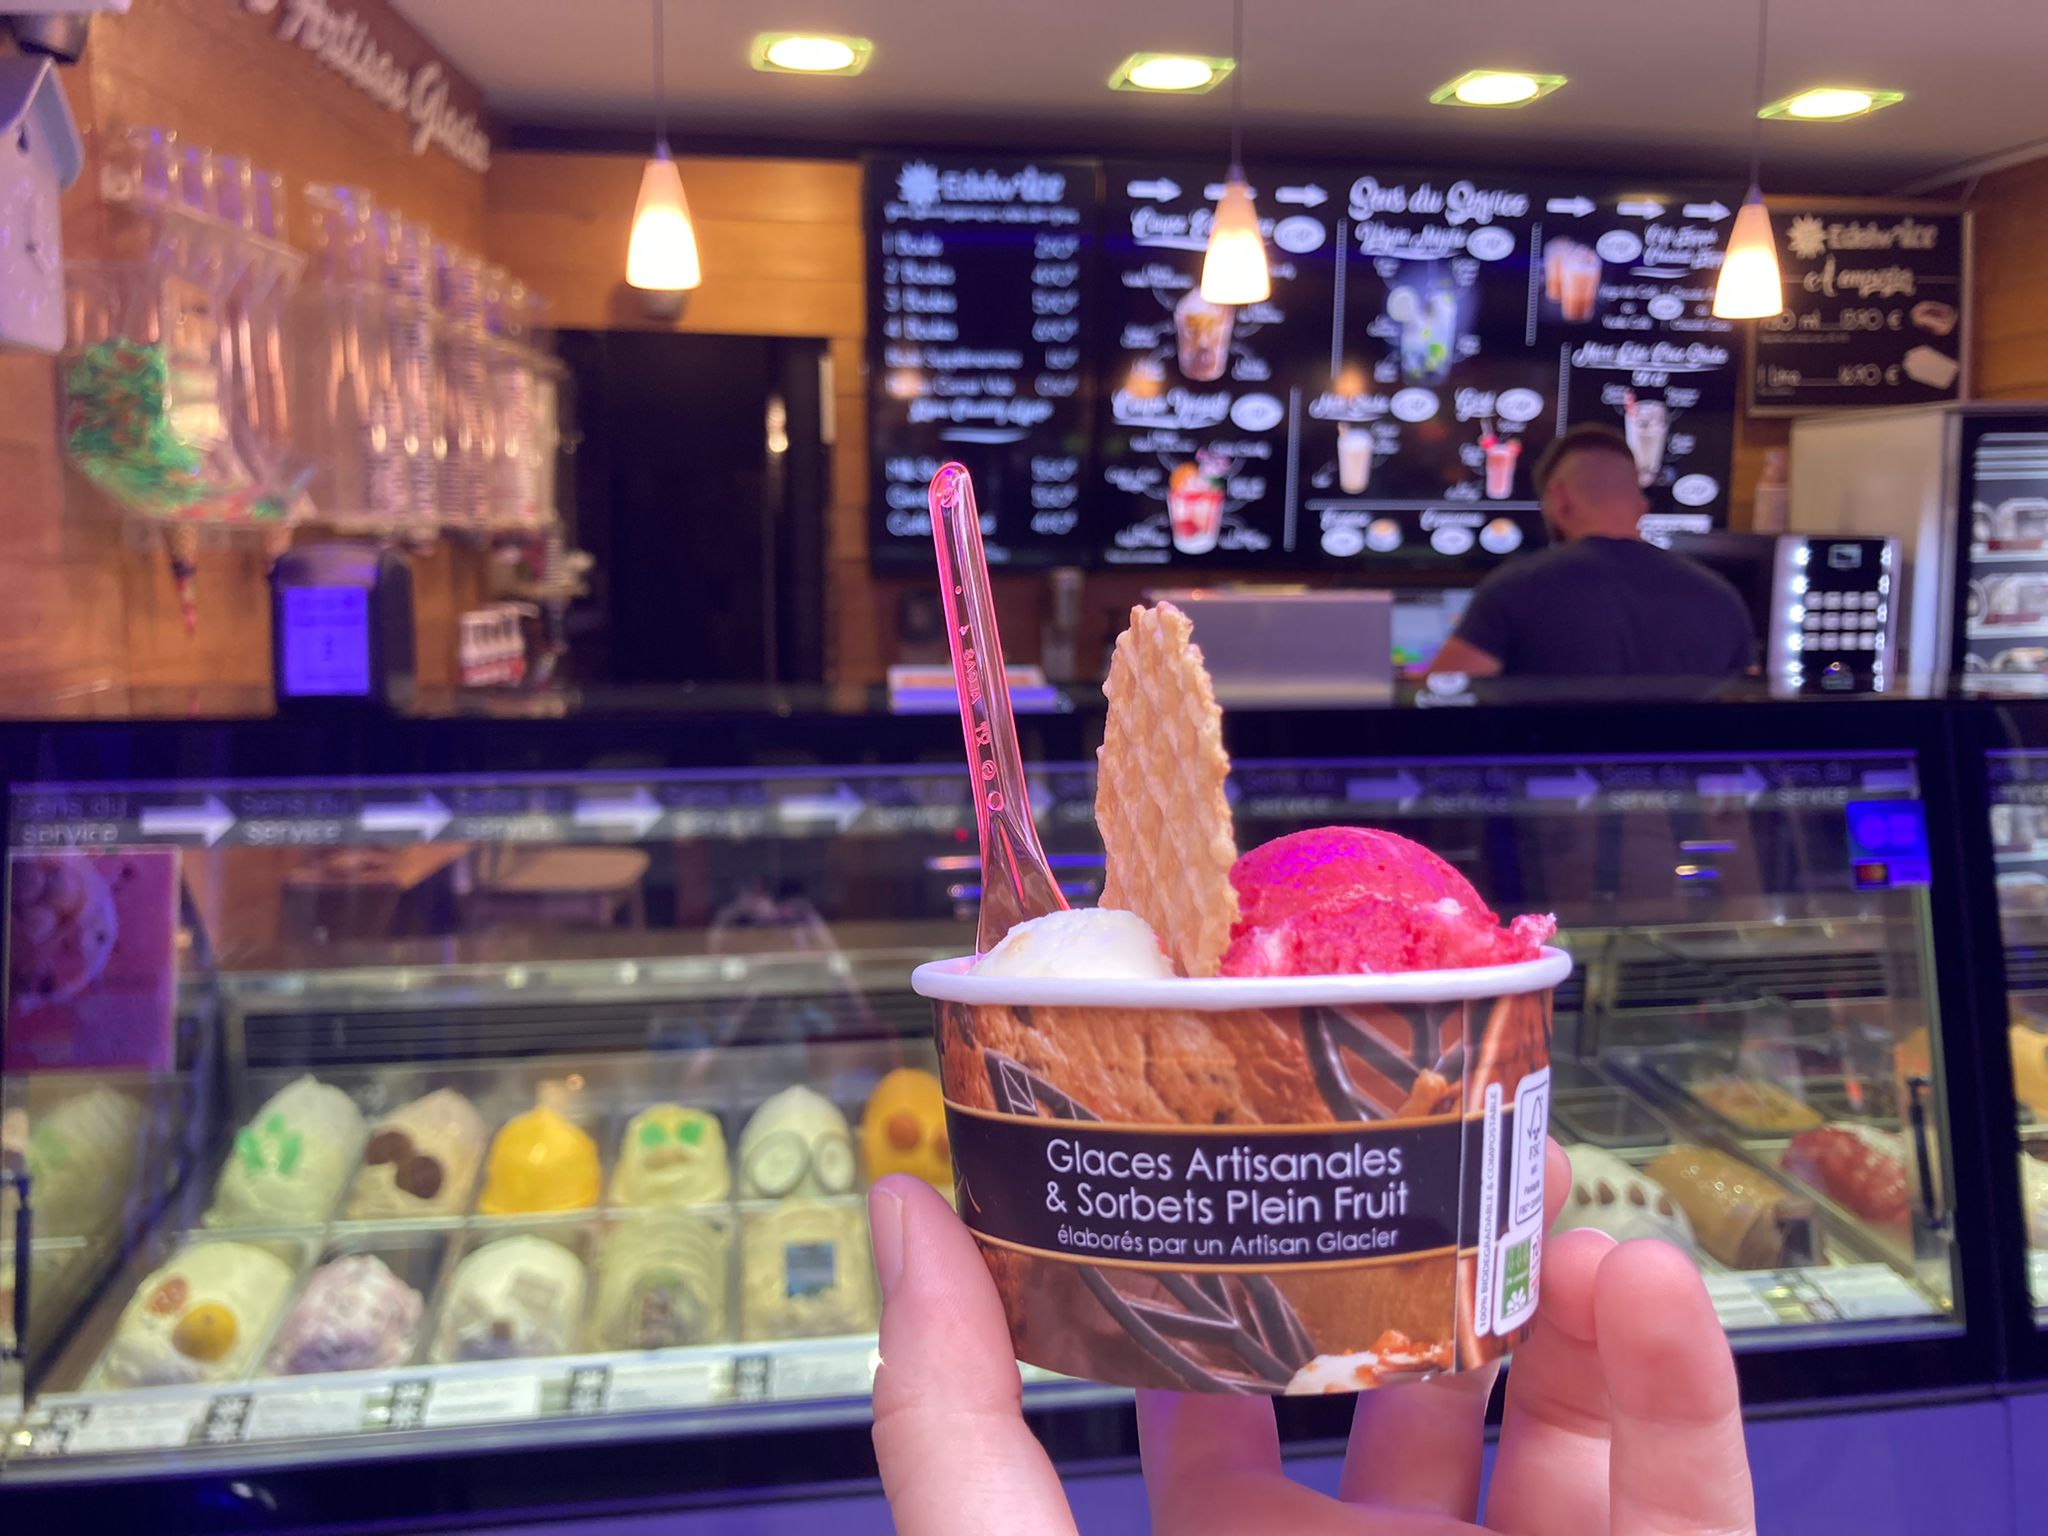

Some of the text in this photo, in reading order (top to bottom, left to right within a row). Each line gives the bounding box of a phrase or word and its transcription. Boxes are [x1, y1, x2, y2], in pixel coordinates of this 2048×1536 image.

[1046, 1138, 1403, 1182] Glaces Artisanales
[1045, 1180, 1409, 1225] & Sorbets Plein Fruit
[1057, 1224, 1399, 1257] élaborés par un Artisan Glacier
